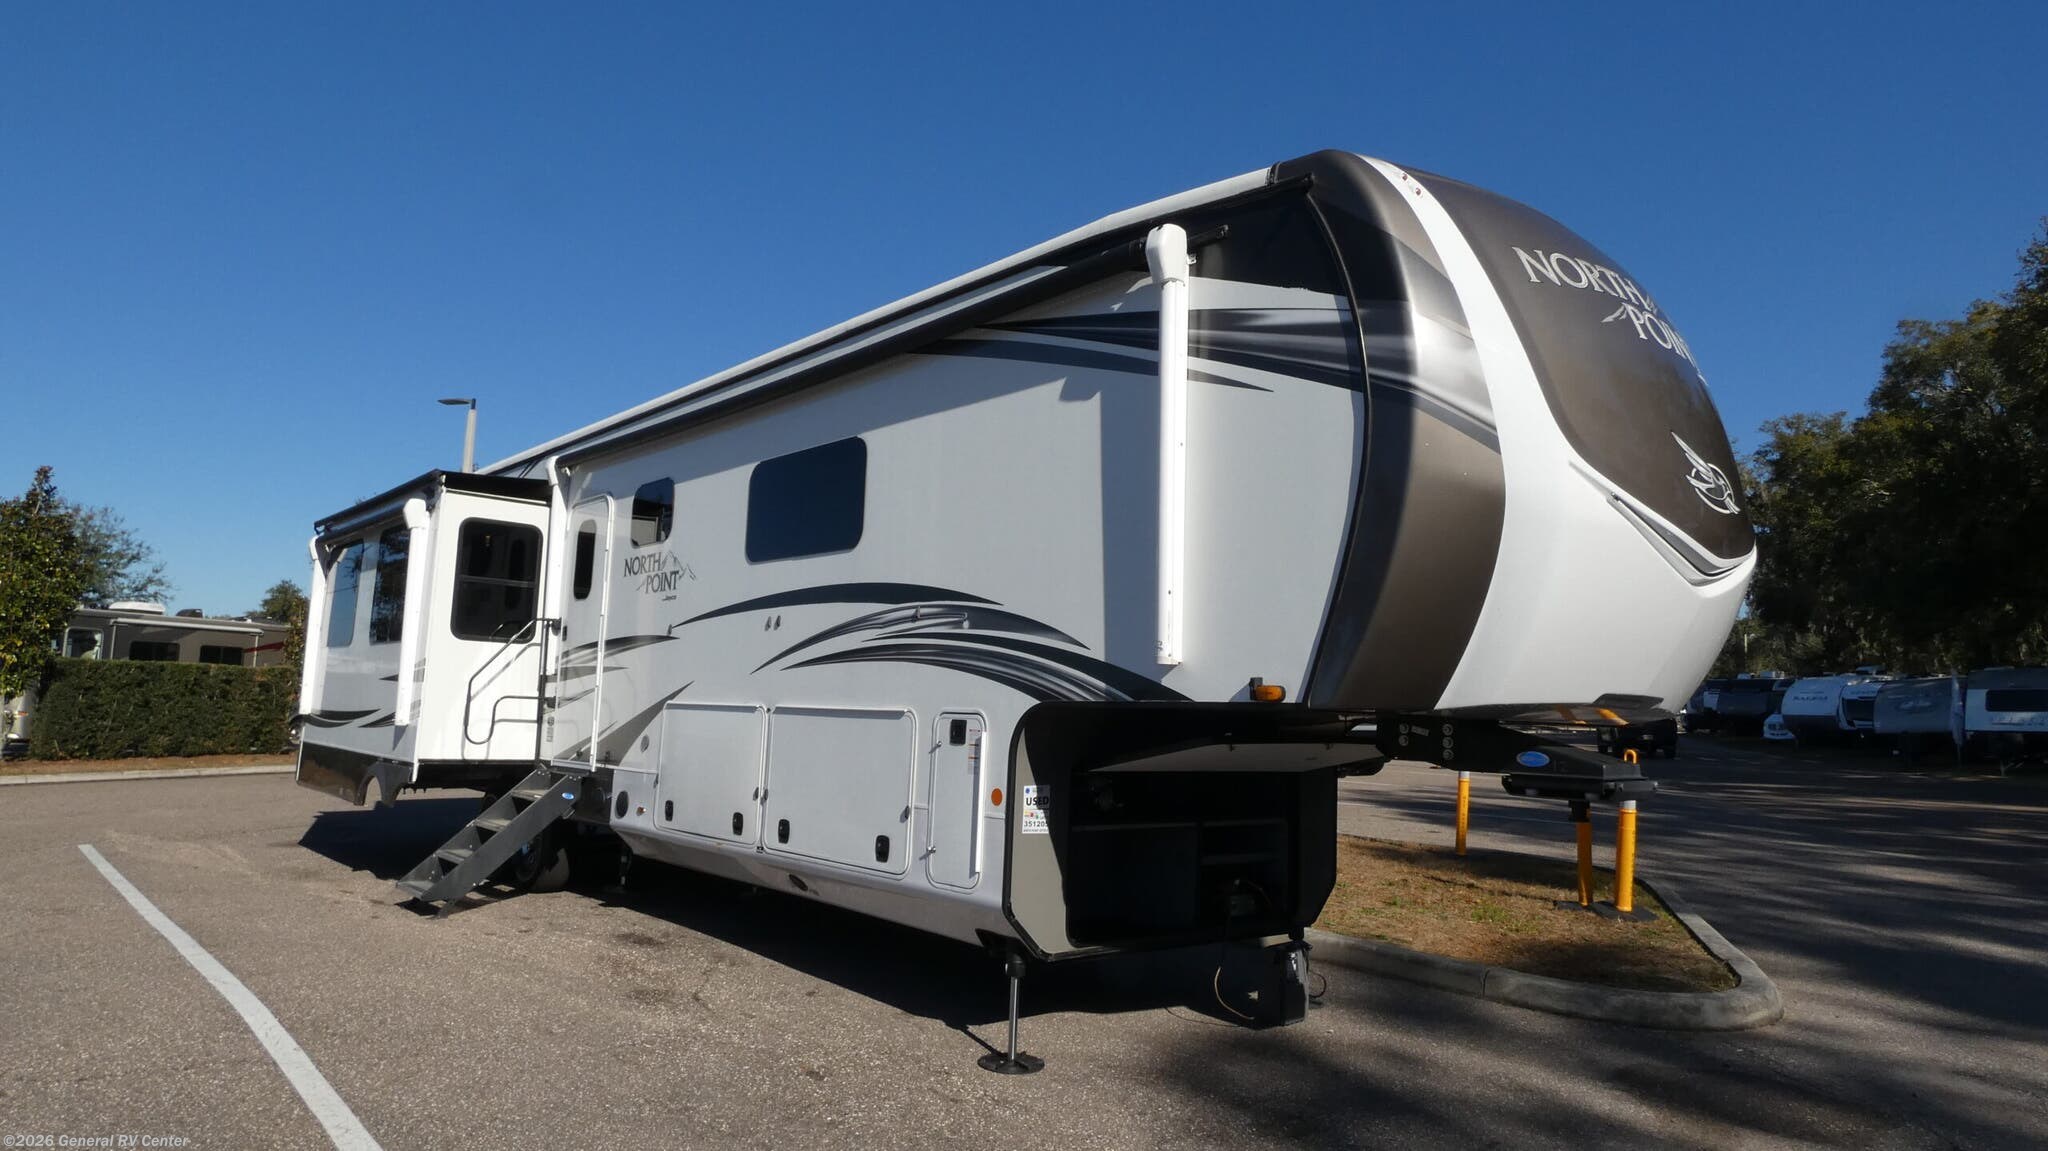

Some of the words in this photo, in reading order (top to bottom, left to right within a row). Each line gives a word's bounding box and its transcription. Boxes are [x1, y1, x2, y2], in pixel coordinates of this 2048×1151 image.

[1512, 246, 1652, 312] NORTH
[1622, 302, 1702, 374] POIN
[624, 552, 662, 577] NORTH
[645, 570, 679, 594] POINT
[1025, 796, 1049, 806] USED
